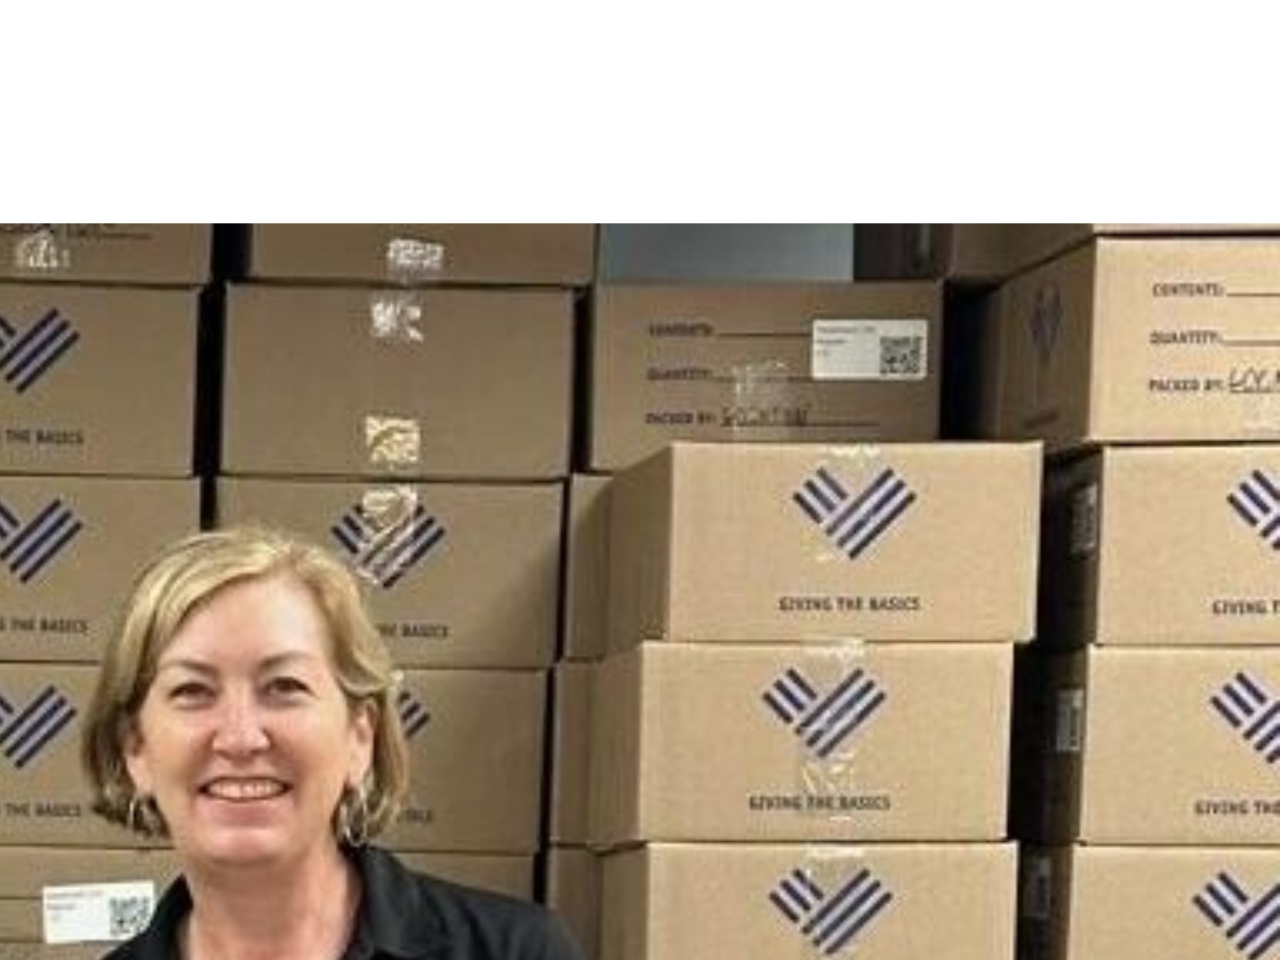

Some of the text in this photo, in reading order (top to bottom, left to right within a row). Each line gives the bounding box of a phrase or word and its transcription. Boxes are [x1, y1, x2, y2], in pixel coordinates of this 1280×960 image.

[779, 596, 920, 611] GIVING THE BASICS
[1212, 599, 1267, 614] GIVING
[749, 796, 890, 811] GIVING THE BASICS
[1195, 800, 1248, 815] GIVING
